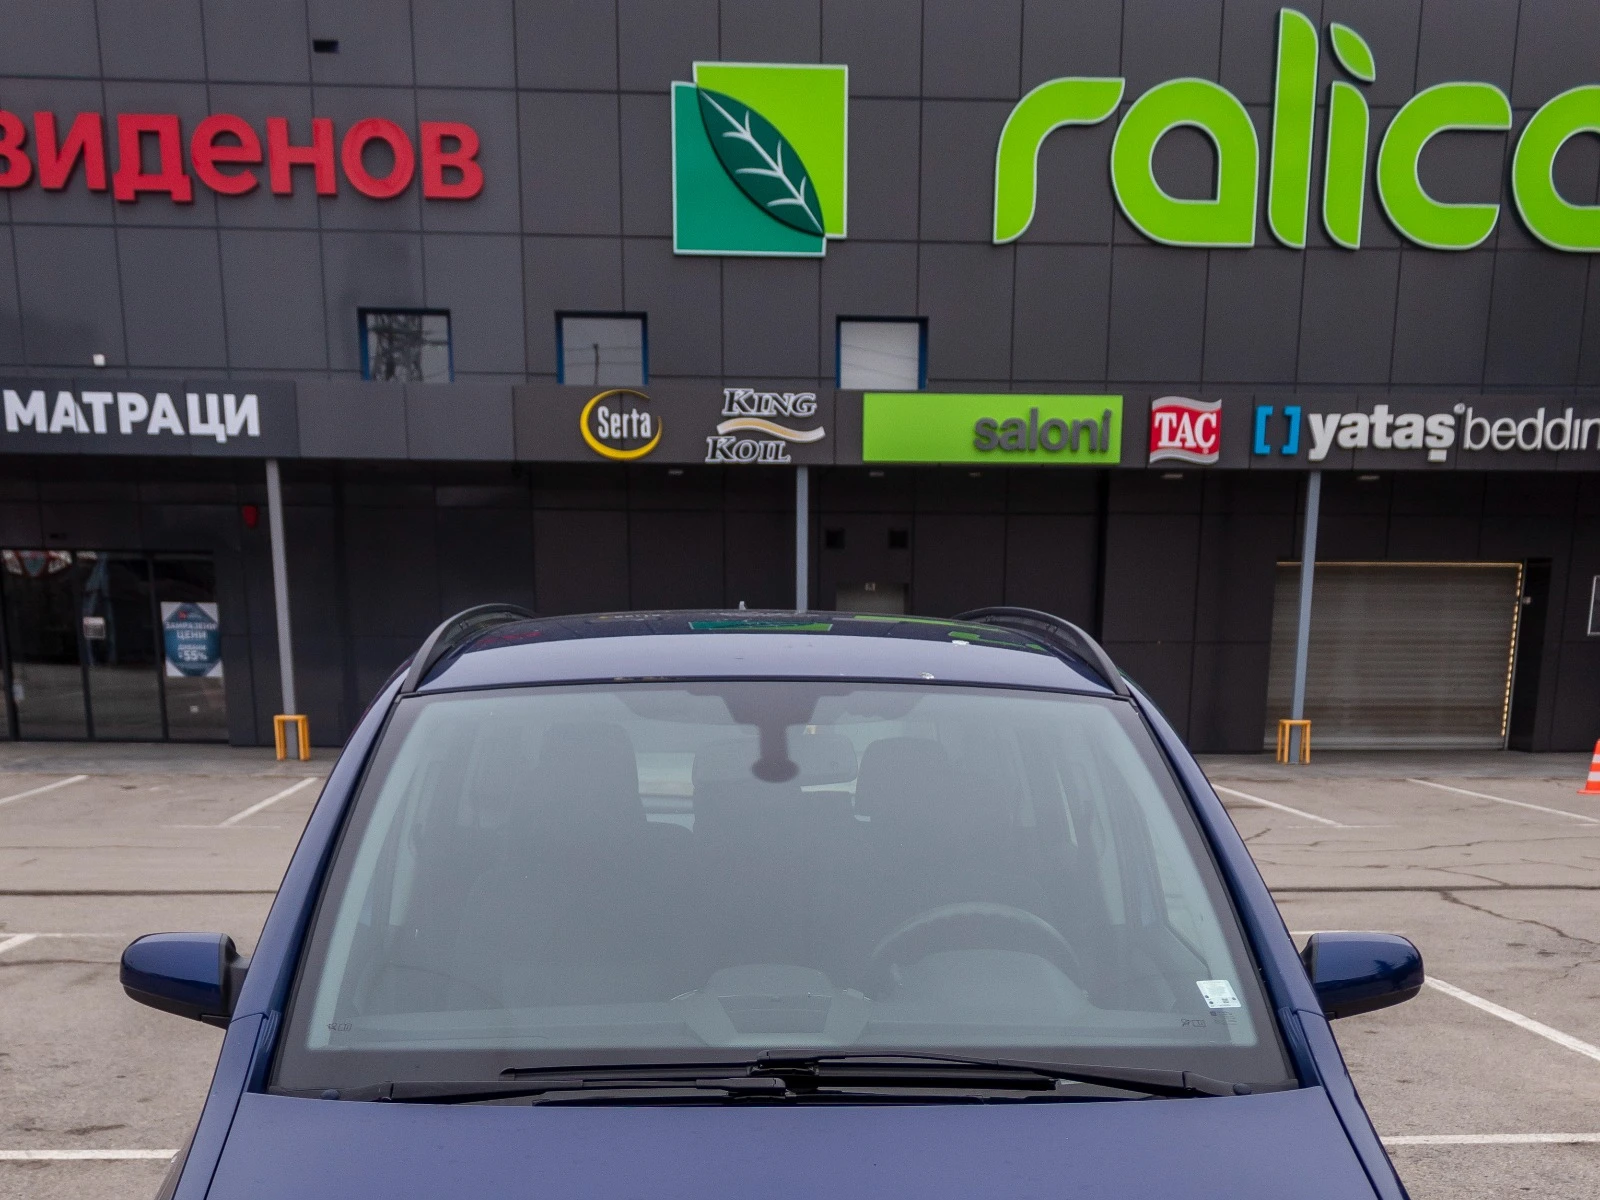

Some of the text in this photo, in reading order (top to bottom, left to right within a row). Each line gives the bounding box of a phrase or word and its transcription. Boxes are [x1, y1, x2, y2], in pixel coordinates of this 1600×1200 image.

[993, 8, 1600, 252] ralica
[3, 389, 261, 443] МАТРАЦИ
[598, 406, 651, 439] Serta
[973, 407, 1113, 453] saloni
[1154, 411, 1217, 455] TAÇ
